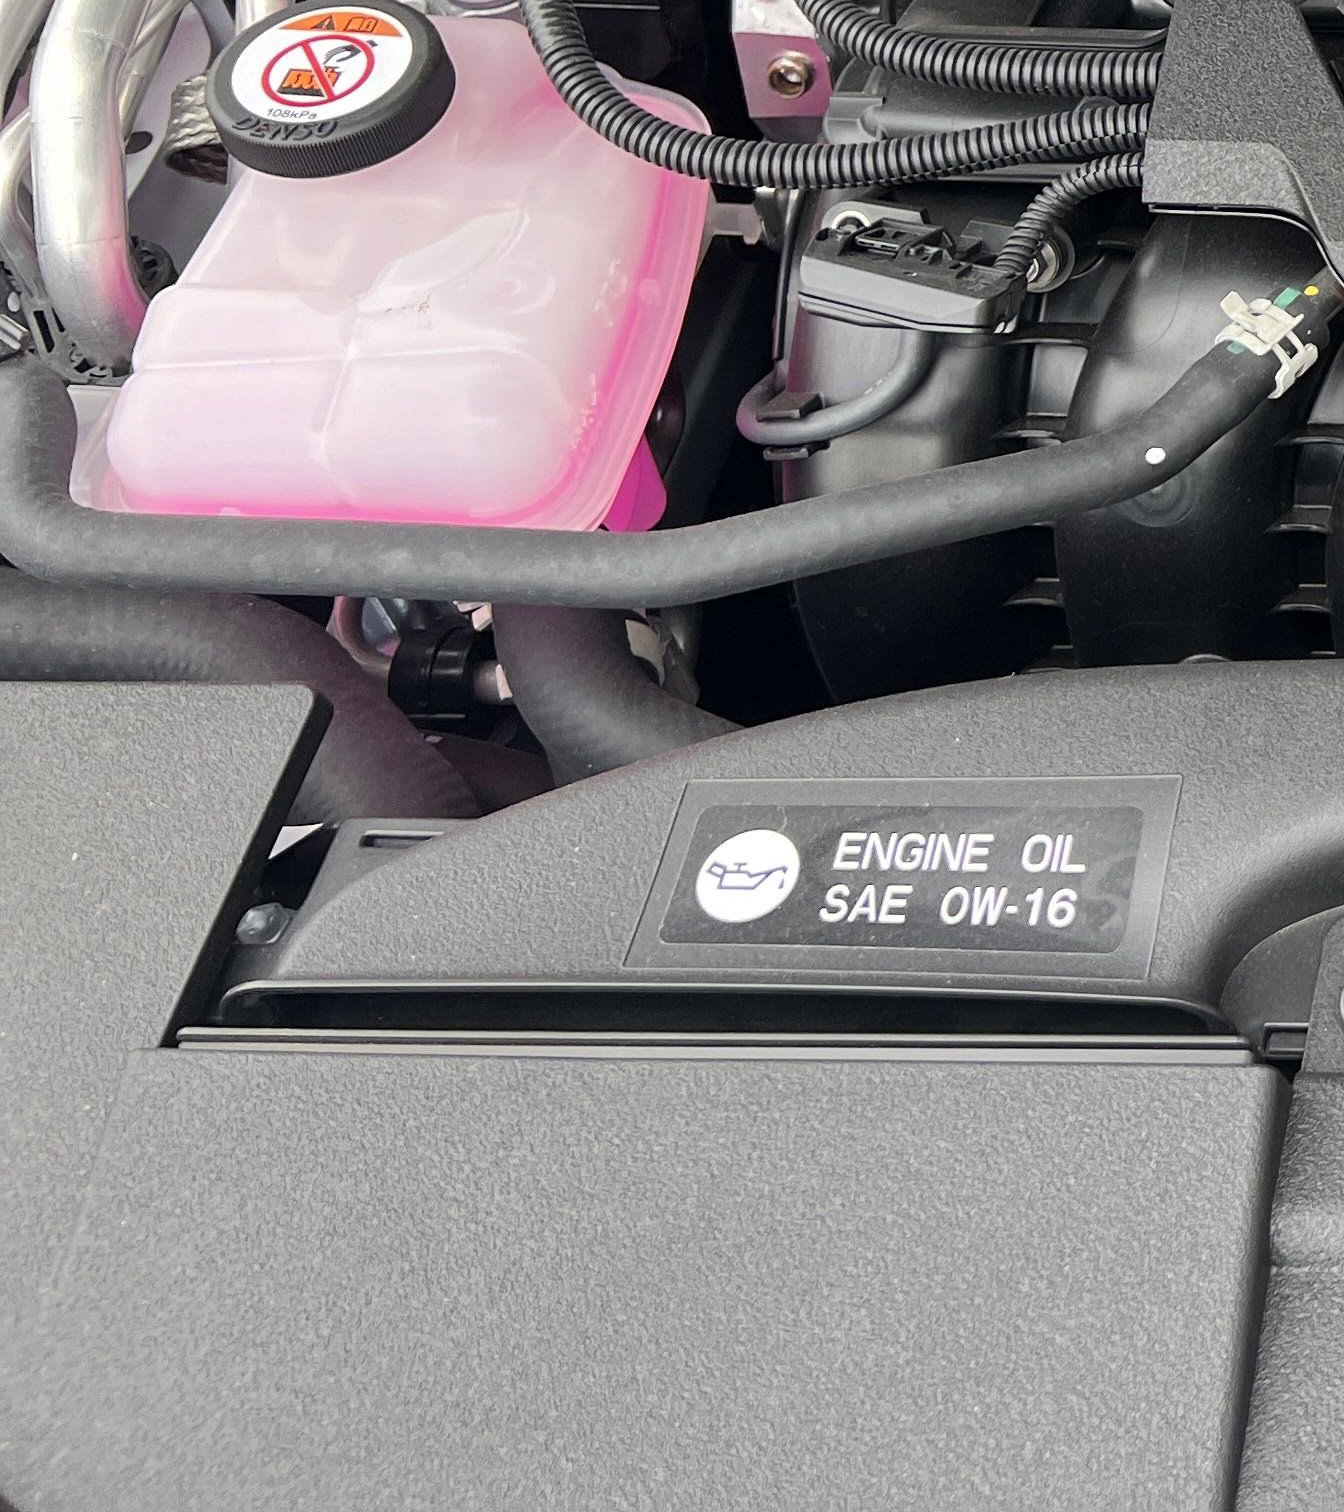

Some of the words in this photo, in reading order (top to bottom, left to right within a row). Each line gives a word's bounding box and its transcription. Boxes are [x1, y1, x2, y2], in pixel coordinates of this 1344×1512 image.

[231, 116, 338, 141] DENSO
[265, 108, 318, 120] 108kPa
[832, 832, 995, 871] ENGINE
[1021, 833, 1086, 873] OIL
[818, 883, 914, 924] SAE
[939, 886, 1078, 928] 0W-16
